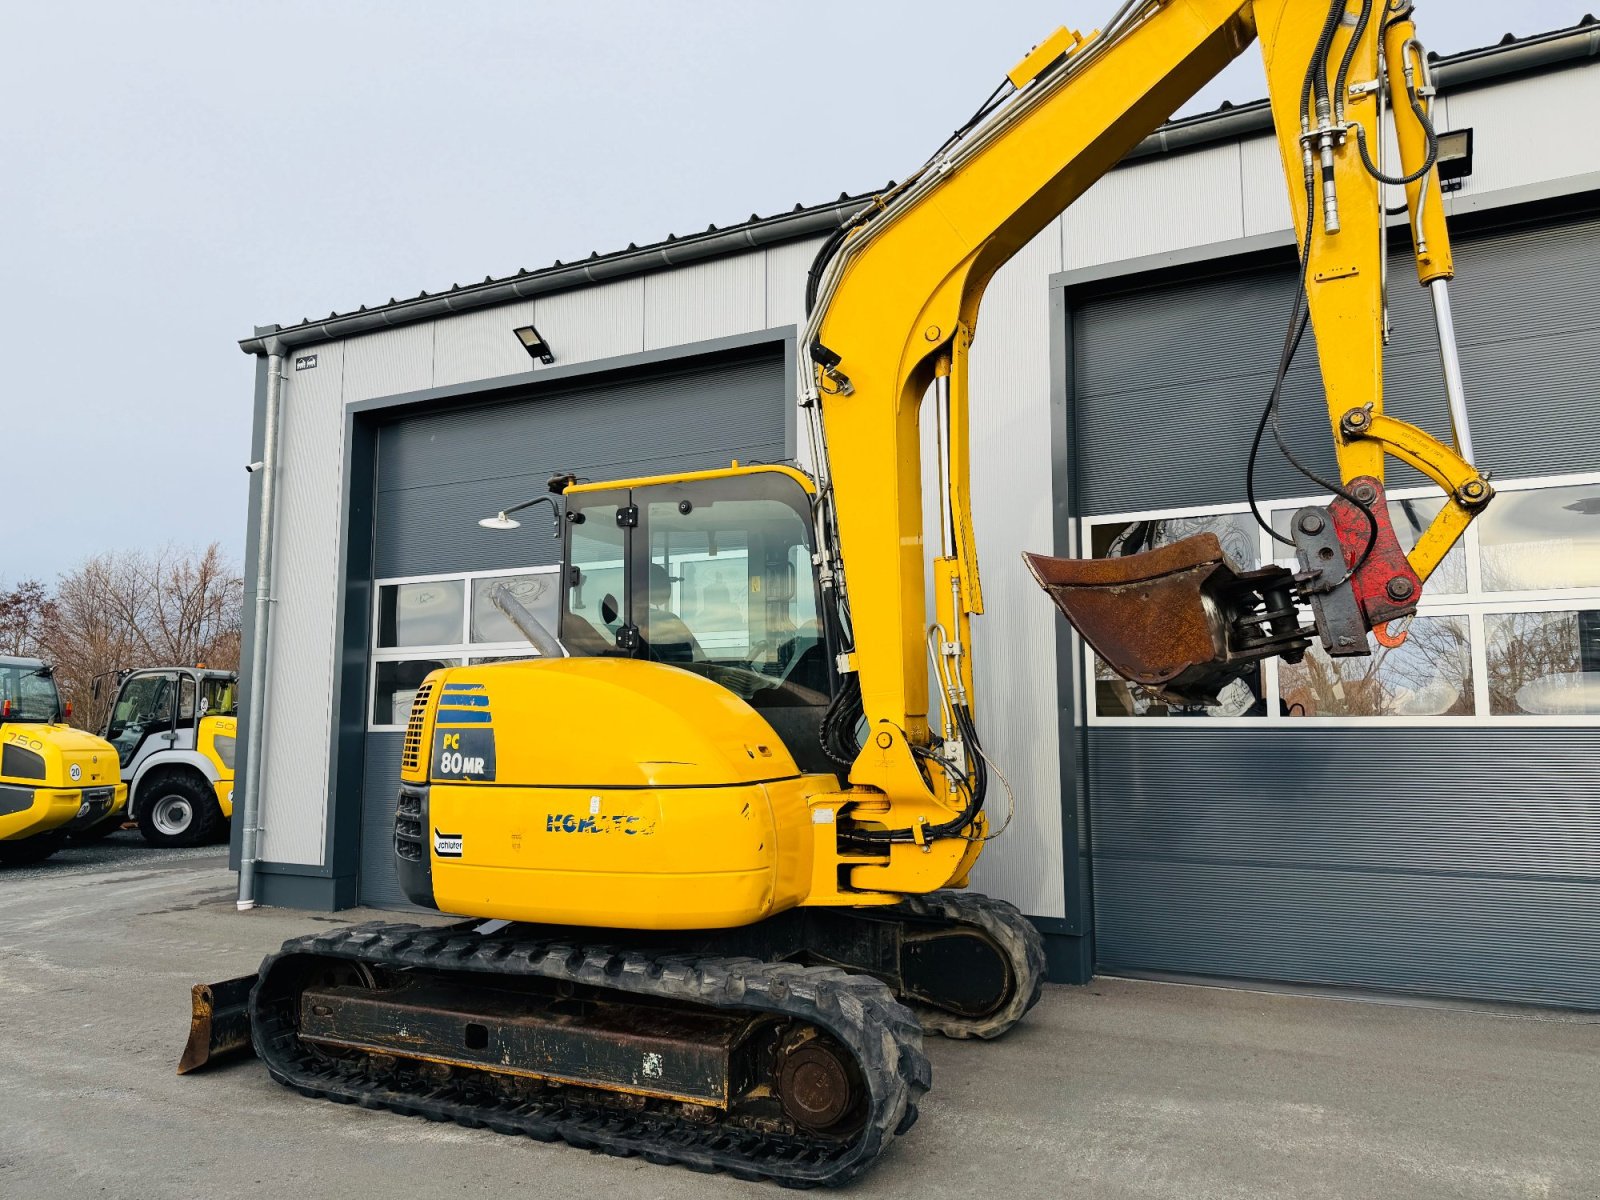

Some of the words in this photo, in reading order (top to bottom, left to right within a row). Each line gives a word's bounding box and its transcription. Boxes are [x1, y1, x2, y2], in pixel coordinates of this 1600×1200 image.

[8, 732, 43, 751] 750
[443, 733, 460, 750] PC
[71, 768, 80, 777] 20
